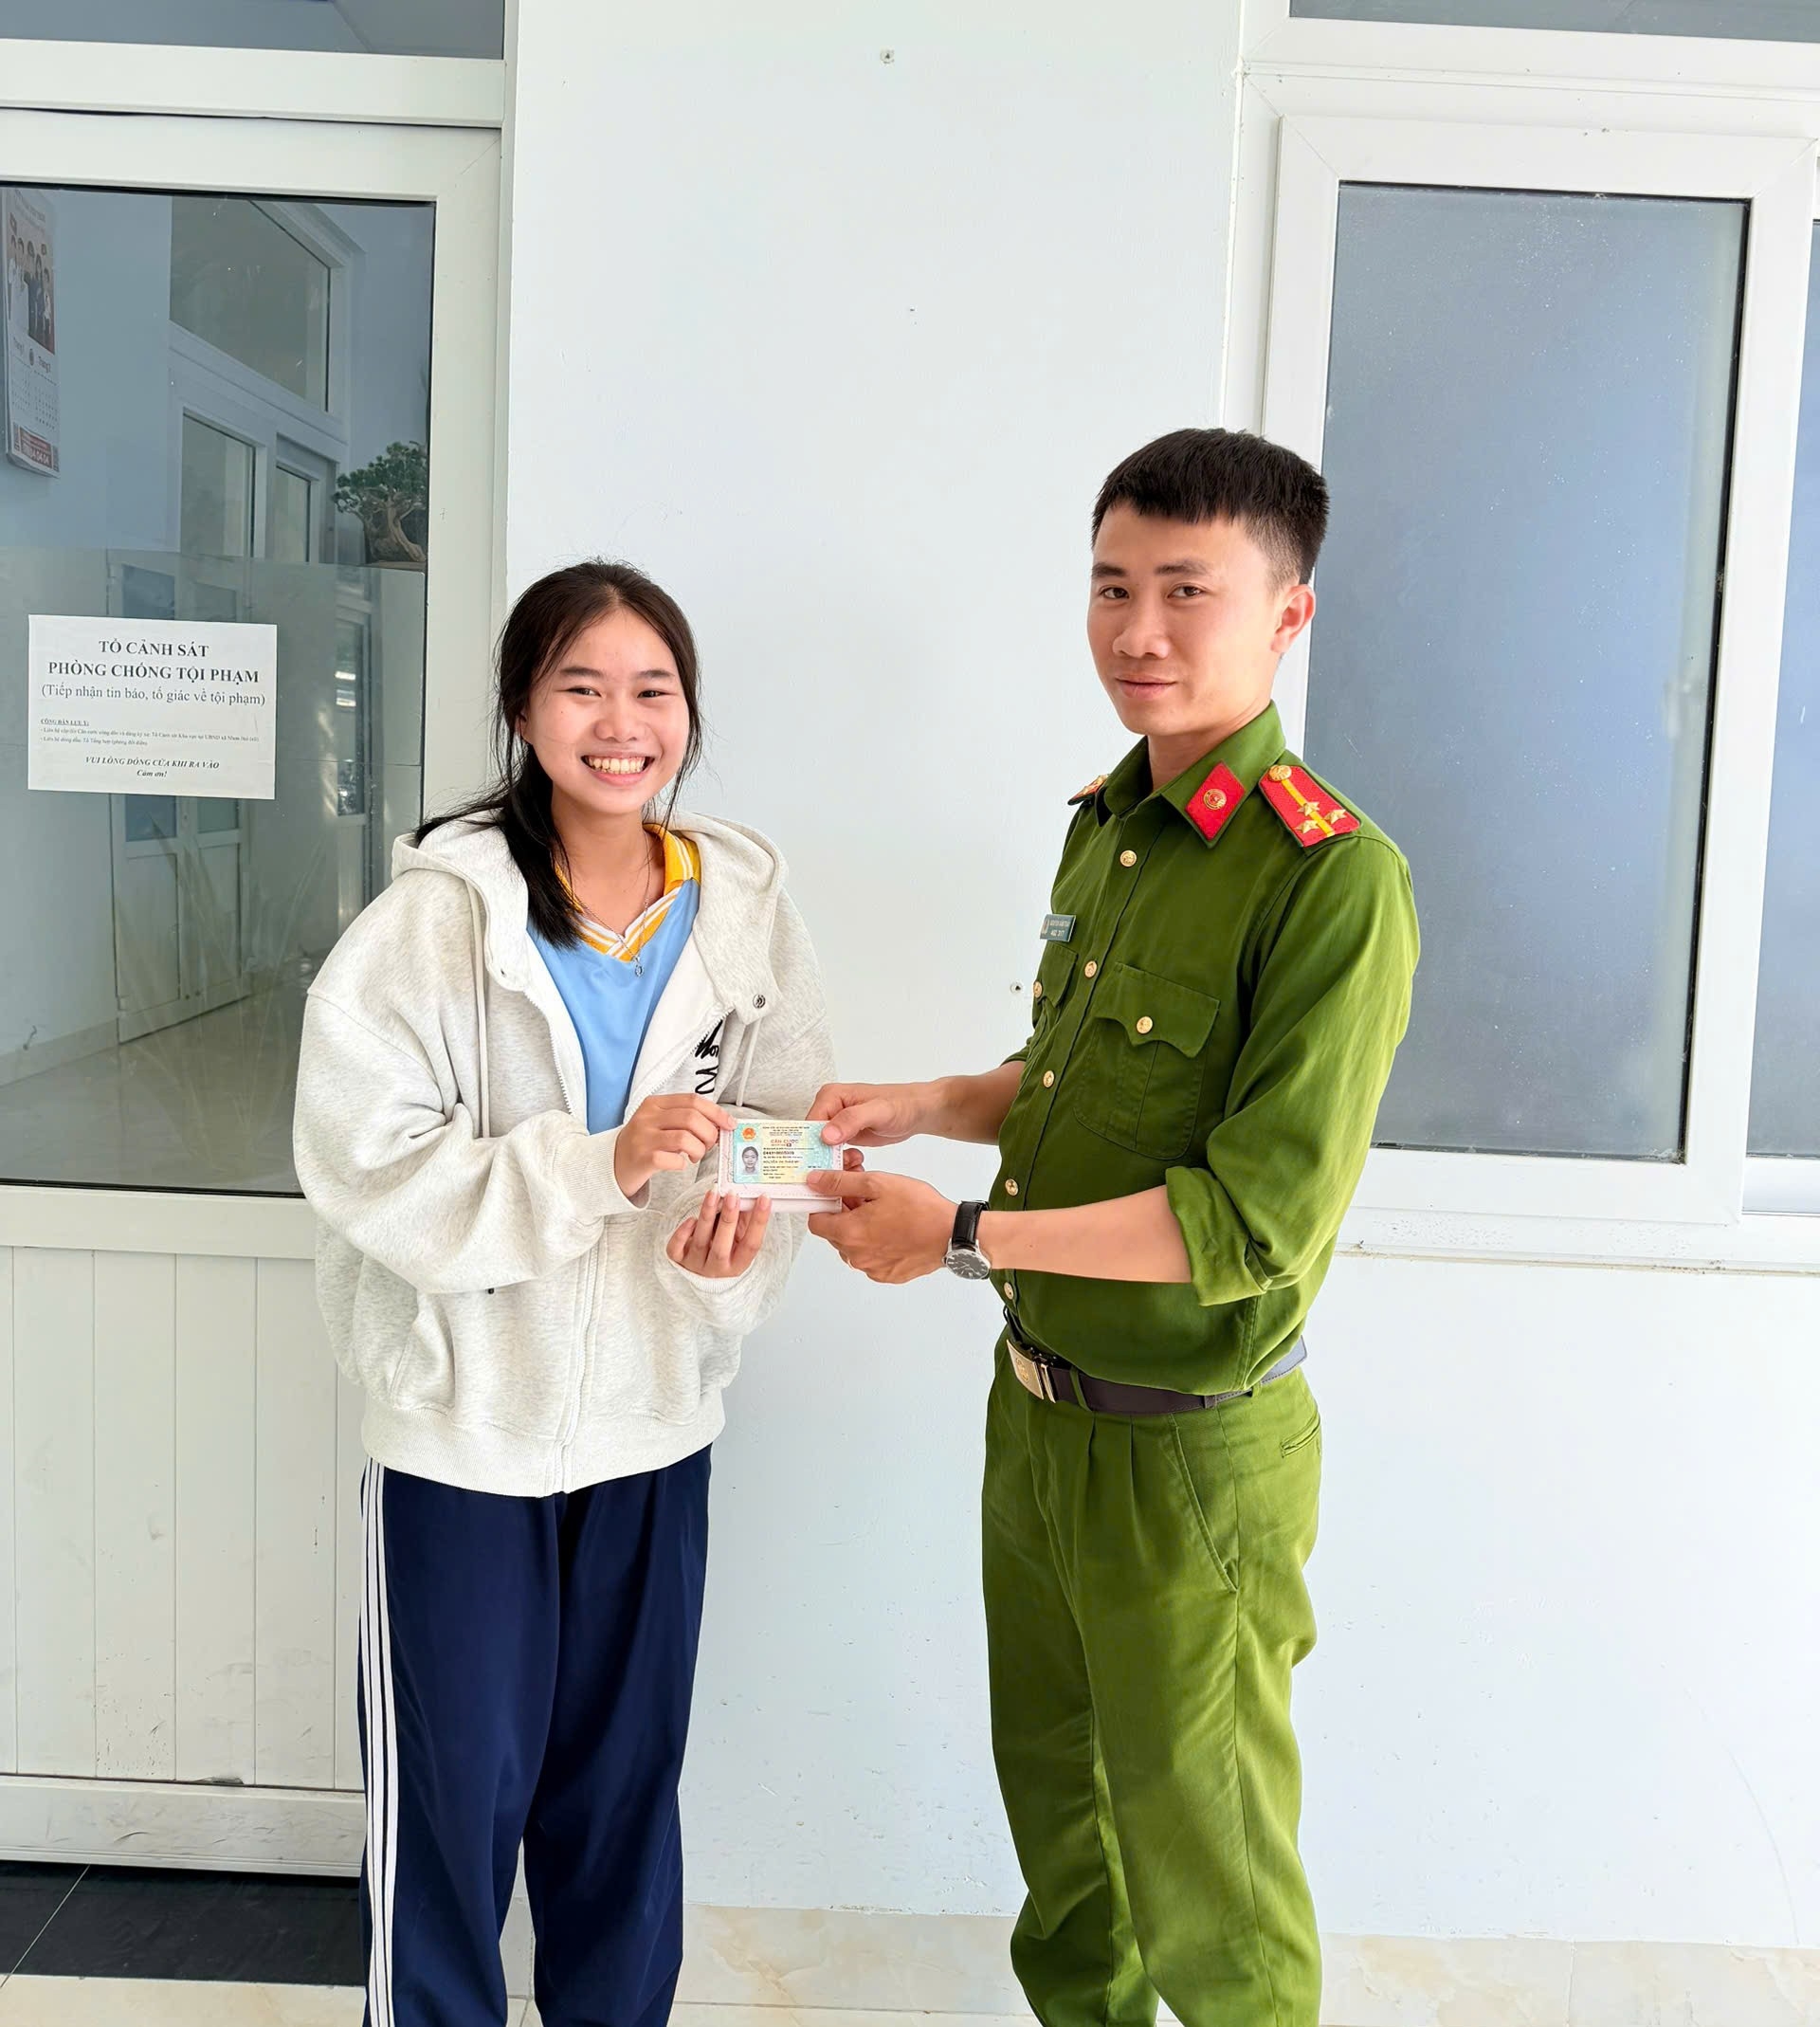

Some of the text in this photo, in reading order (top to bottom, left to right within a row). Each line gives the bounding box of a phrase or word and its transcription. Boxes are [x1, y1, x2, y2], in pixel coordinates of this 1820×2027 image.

[99, 638, 209, 657] TỔ CẢNH SÁT
[48, 659, 259, 685] PHÒNG CHỐNG TỘI PHẠM
[42, 683, 265, 706] (Tiếp nhận tin báo, tố giác về tội phạm)
